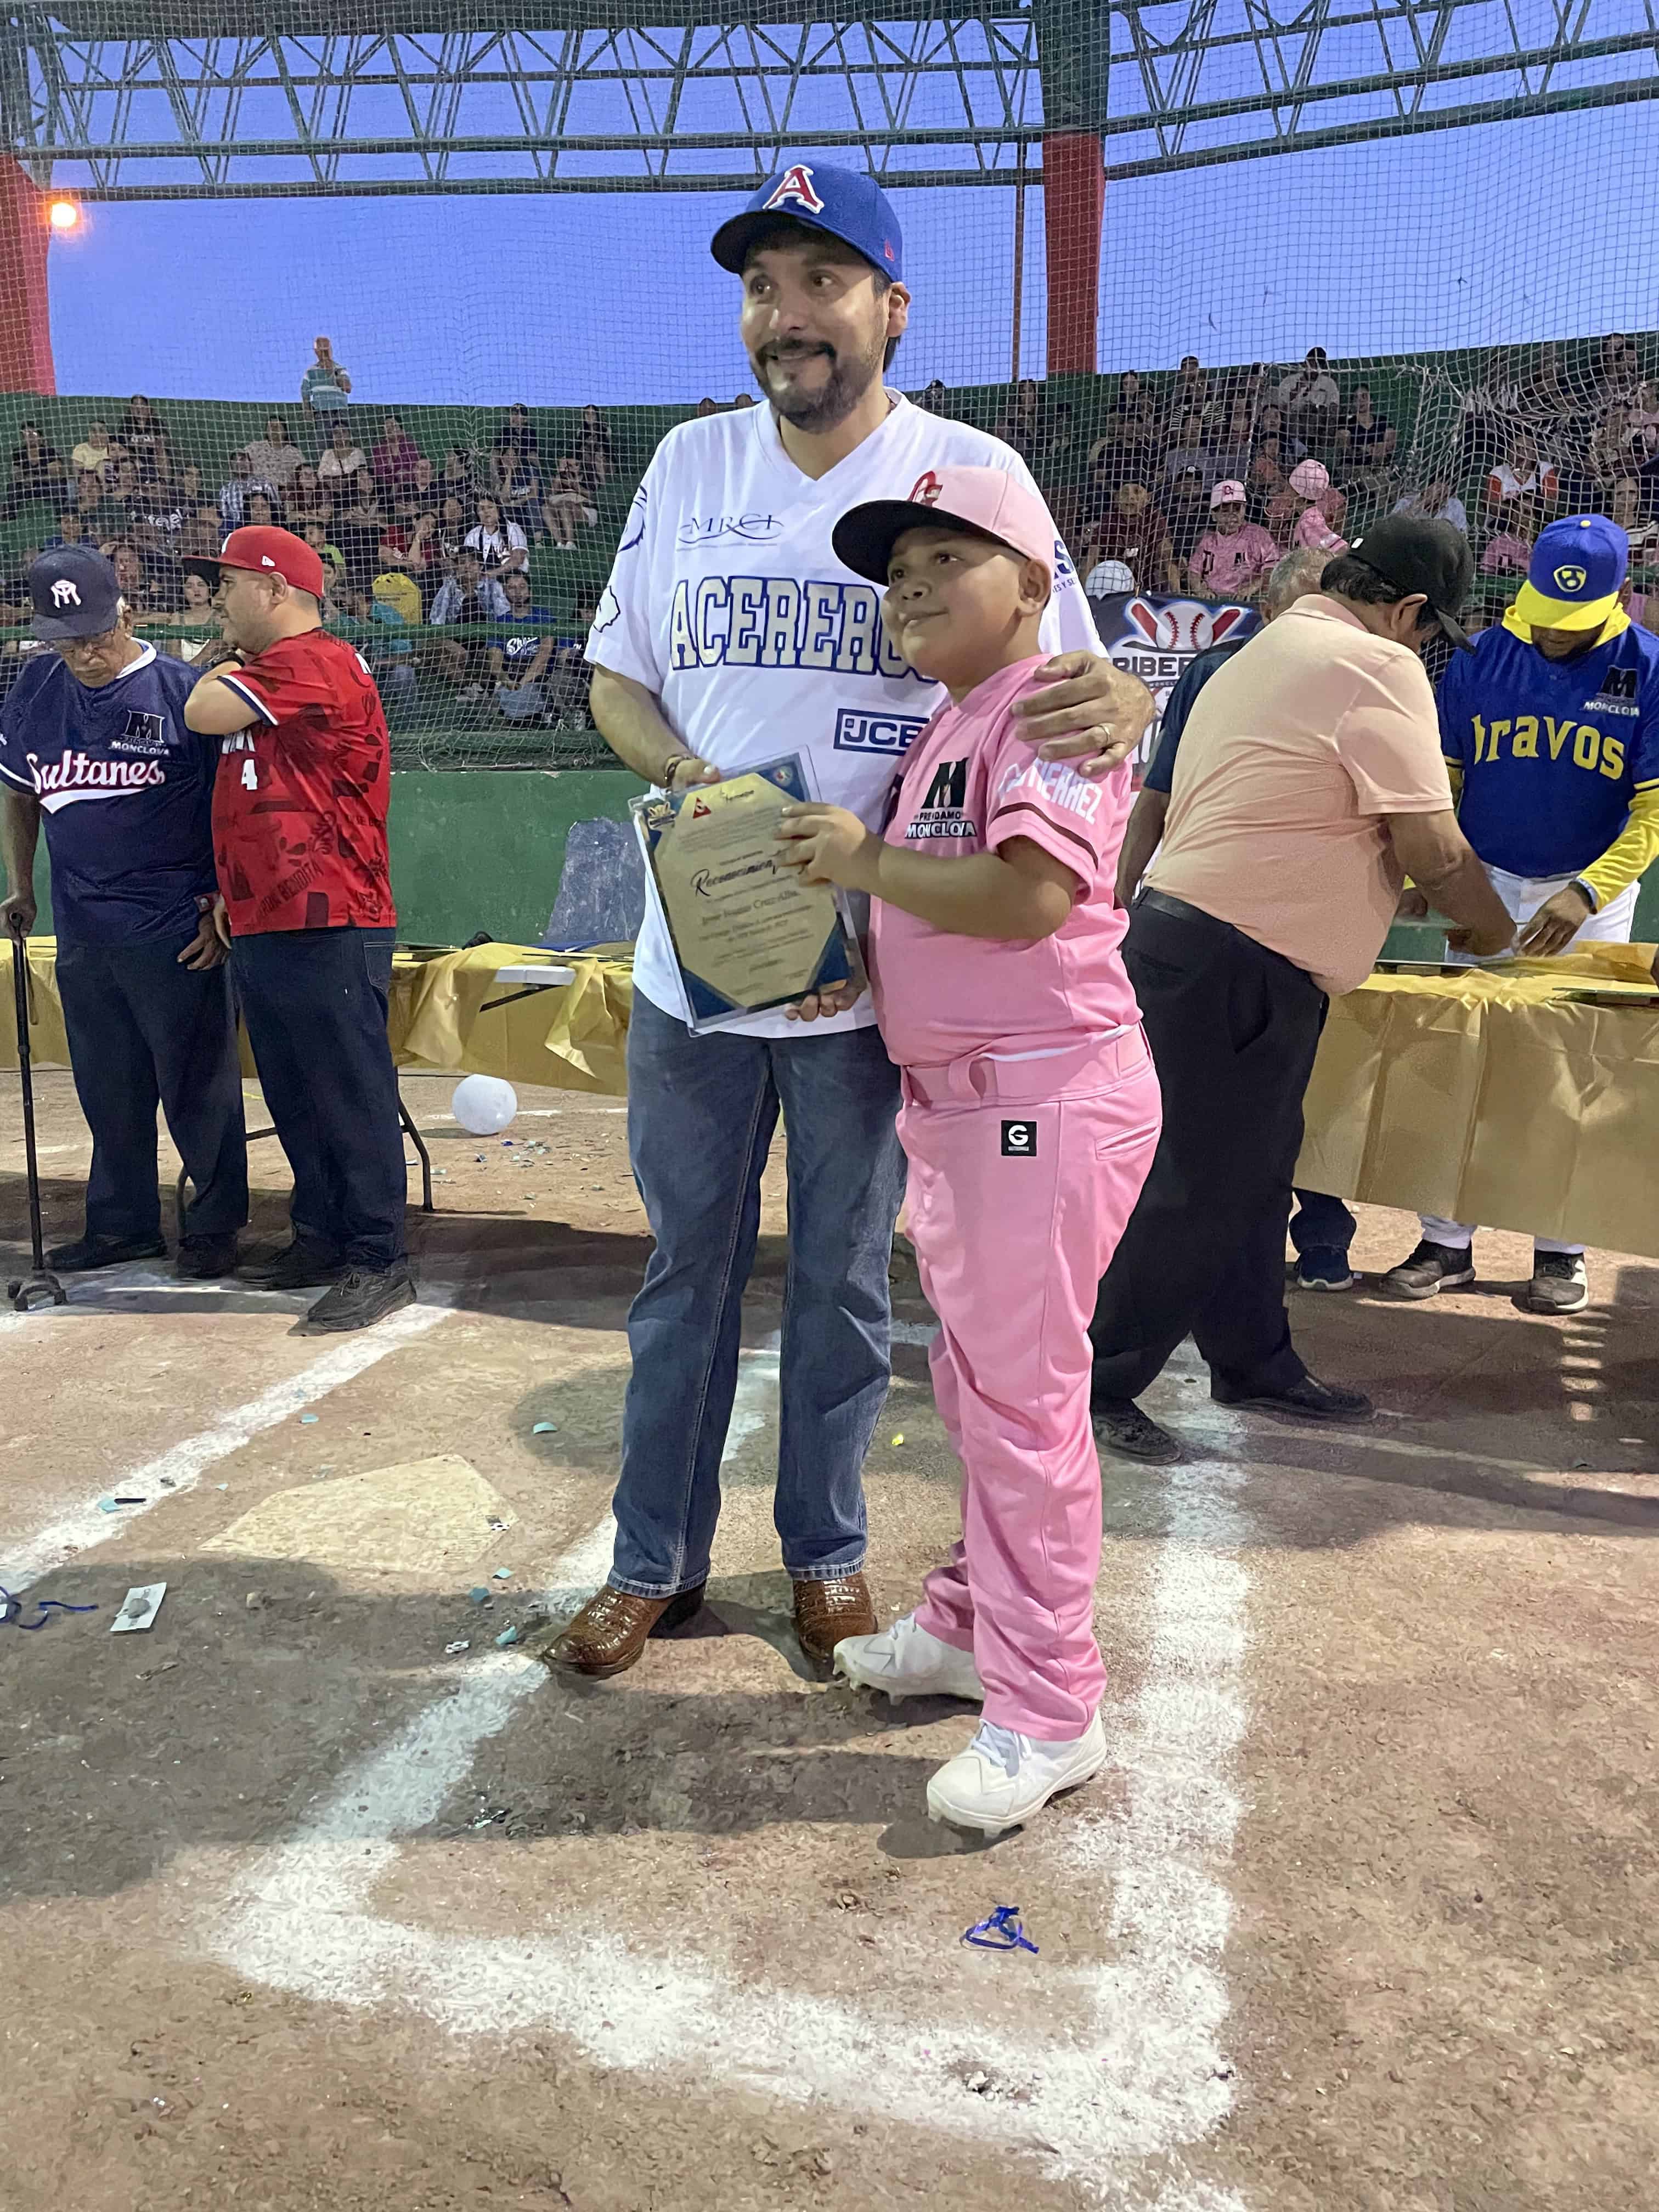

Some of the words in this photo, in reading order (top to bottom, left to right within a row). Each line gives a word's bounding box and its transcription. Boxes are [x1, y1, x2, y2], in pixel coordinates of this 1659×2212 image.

[762, 164, 825, 214] A
[670, 575, 940, 684] ACERER
[111, 741, 170, 755] MONCLOVA
[26, 750, 165, 794] Sultanes
[241, 759, 258, 791] 4
[1008, 1125, 1029, 1146] G
